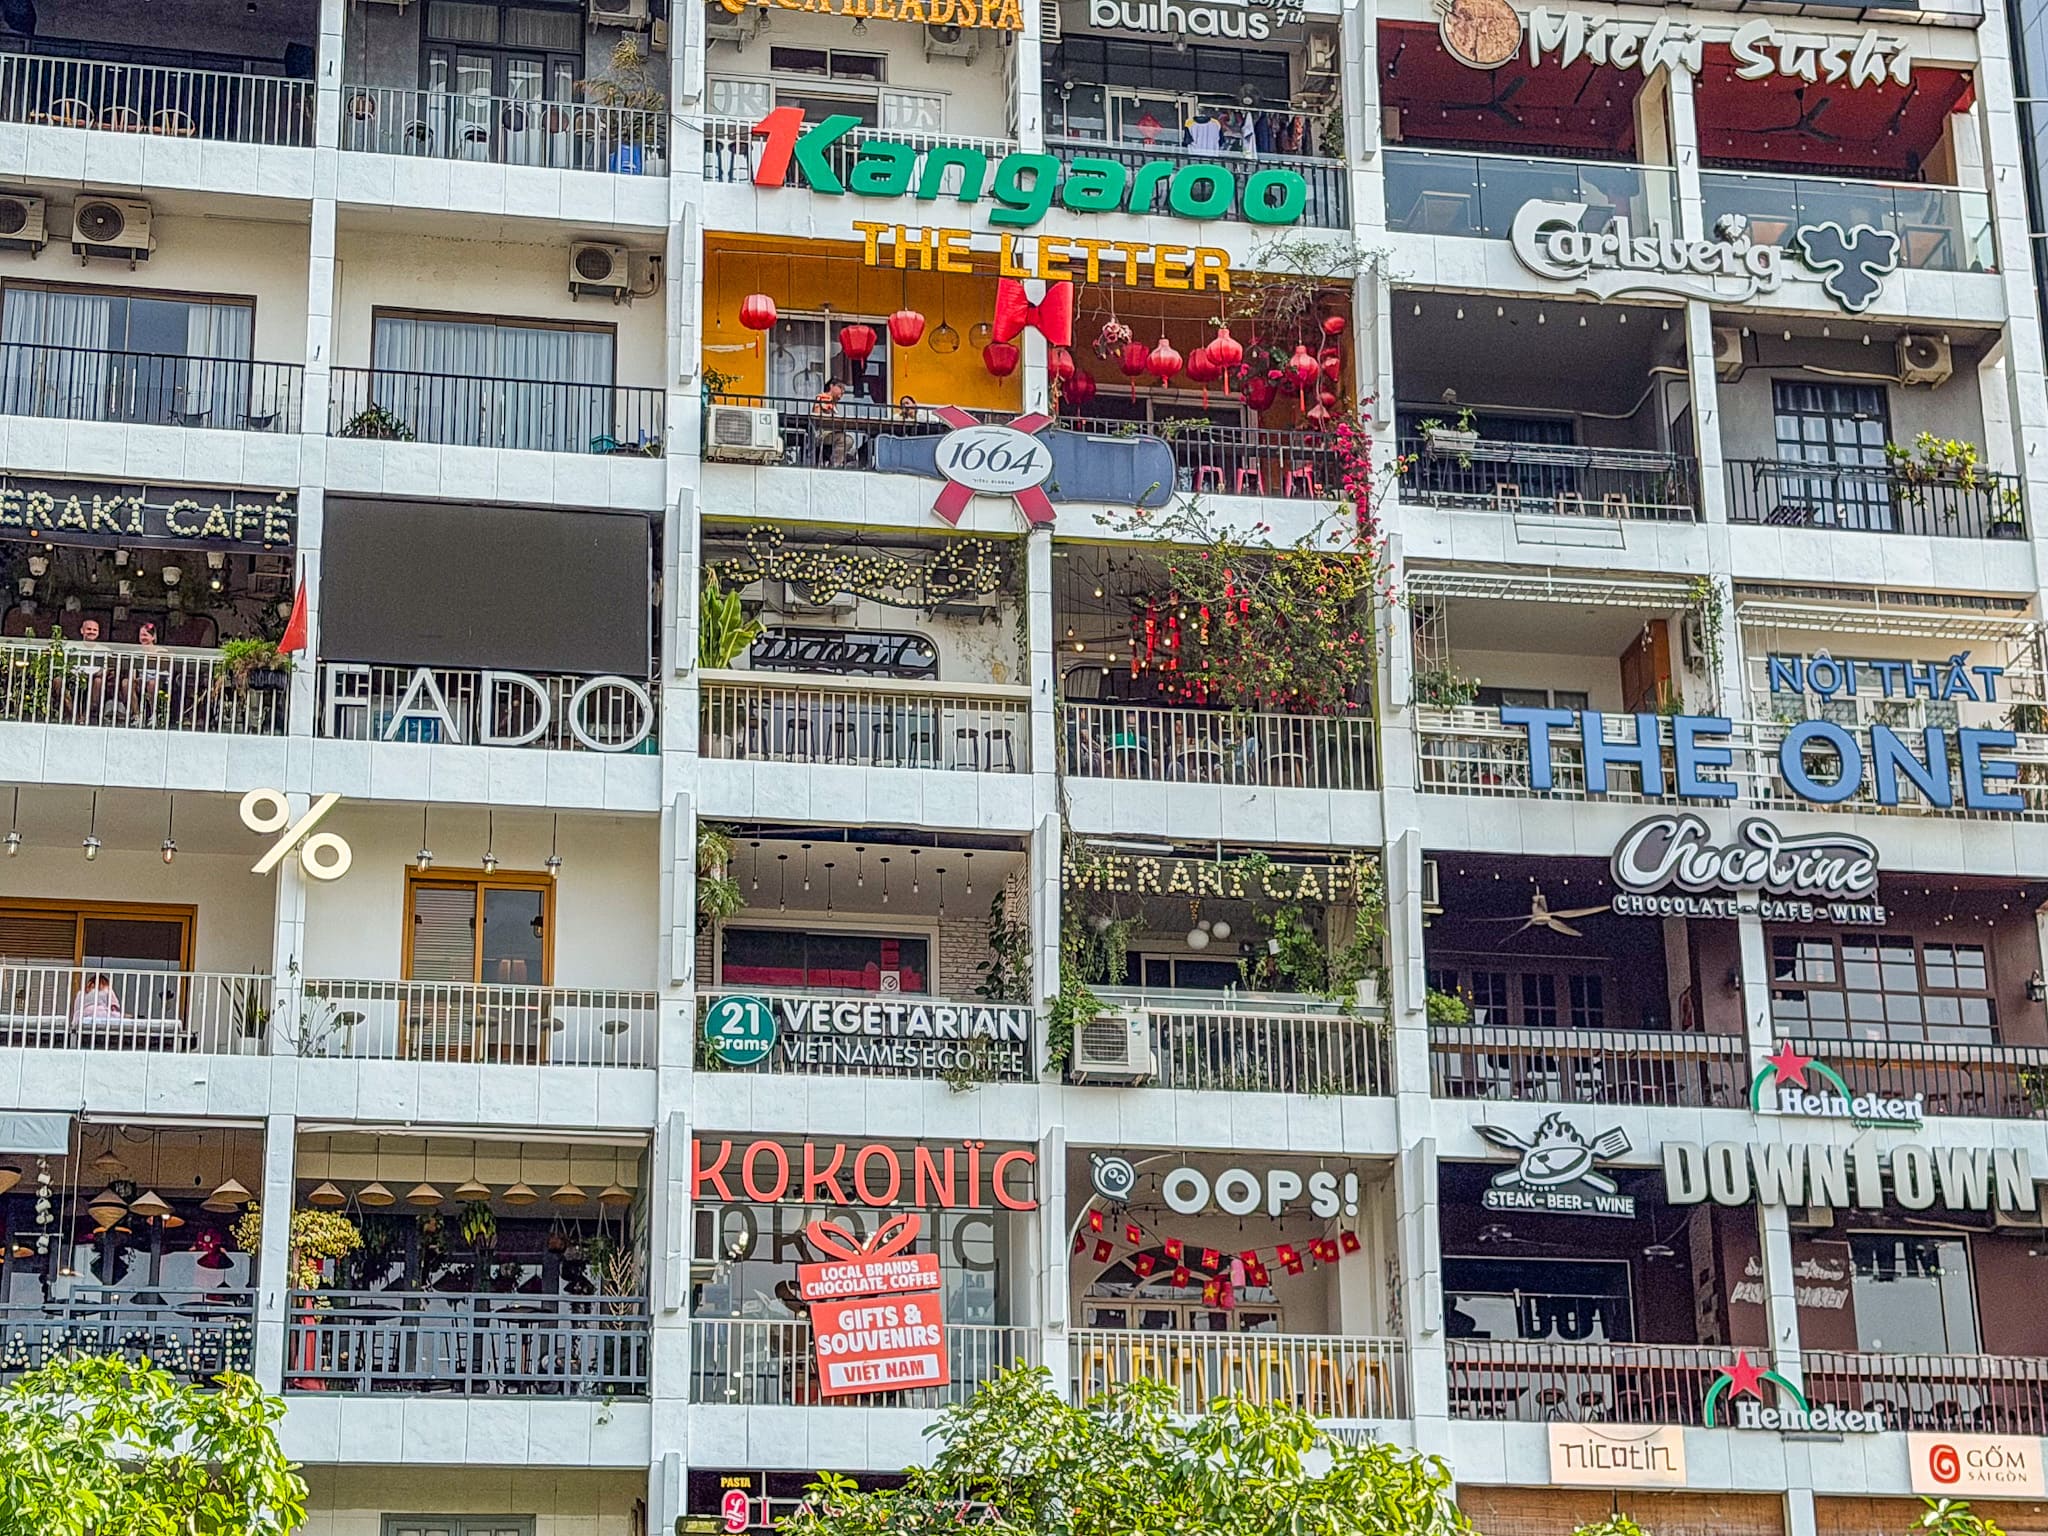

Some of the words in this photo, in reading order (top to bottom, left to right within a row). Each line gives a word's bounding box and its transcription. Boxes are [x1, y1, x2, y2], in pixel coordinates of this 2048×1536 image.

[1529, 9, 1703, 77] Michi
[1730, 18, 1914, 89] Sushi
[852, 220, 973, 274] THE
[1000, 231, 1232, 293] LETTER
[1512, 199, 1785, 295] Carlsberg
[949, 438, 1044, 476] 1664
[326, 663, 654, 753] FADO
[1500, 706, 1738, 800] THE
[1779, 720, 2025, 813] ONE
[1616, 896, 1738, 917] CHOCOLATE
[1833, 904, 1887, 923] WINE
[721, 1002, 761, 1036] 21
[783, 1000, 1028, 1041] VEGETARIAN
[713, 1036, 769, 1051] Grams
[1778, 1088, 1924, 1120] Heineken
[1163, 1167, 1359, 1219] OOPS!
[1487, 1191, 1536, 1208] STEAK
[1547, 1194, 1582, 1210] BEER
[1595, 1196, 1635, 1214] WINE
[806, 1276, 888, 1297] CHOCOLATE,
[890, 1272, 938, 1288] COFFEE
[820, 1264, 863, 1282] LOCAL
[865, 1260, 920, 1278] BRANDS
[838, 1306, 899, 1331] GIFTS
[904, 1304, 922, 1325] &
[818, 1324, 941, 1356] SOUVENIRS
[886, 1359, 925, 1379] NAM
[1735, 1401, 1886, 1432] Heineken
[1559, 1439, 1677, 1471] nicotin
[720, 1477, 751, 1488] PASTA
